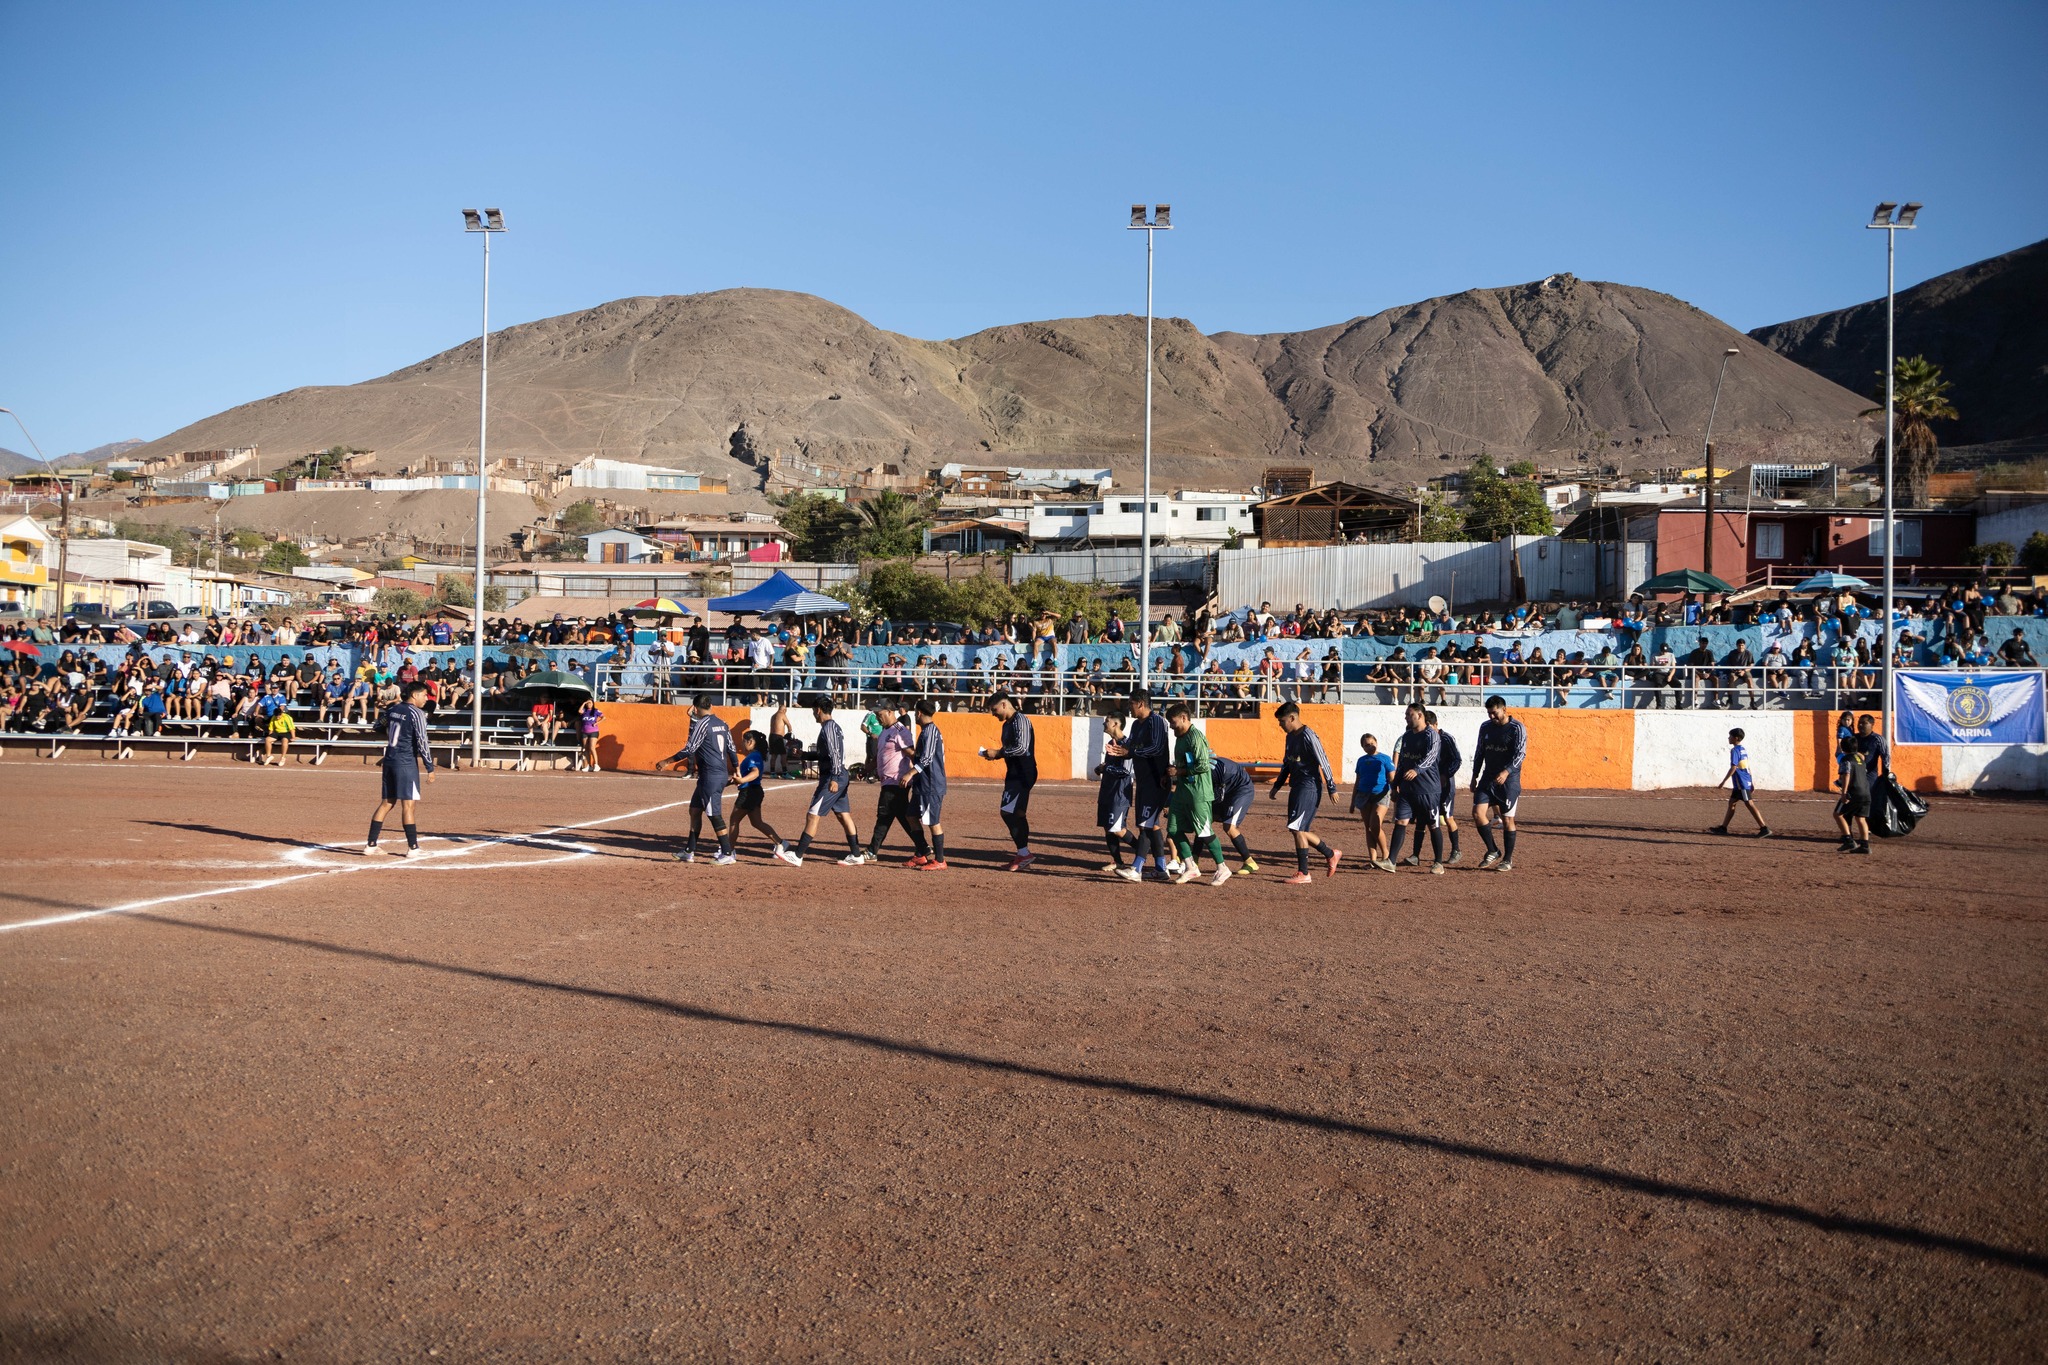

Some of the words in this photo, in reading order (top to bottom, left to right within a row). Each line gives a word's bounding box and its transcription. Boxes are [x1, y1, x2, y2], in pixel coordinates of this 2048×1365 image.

[1953, 687, 1976, 697] KARINA
[1952, 728, 1992, 737] KARINA
[1505, 798, 1512, 809] 4
[1141, 805, 1151, 818] 16
